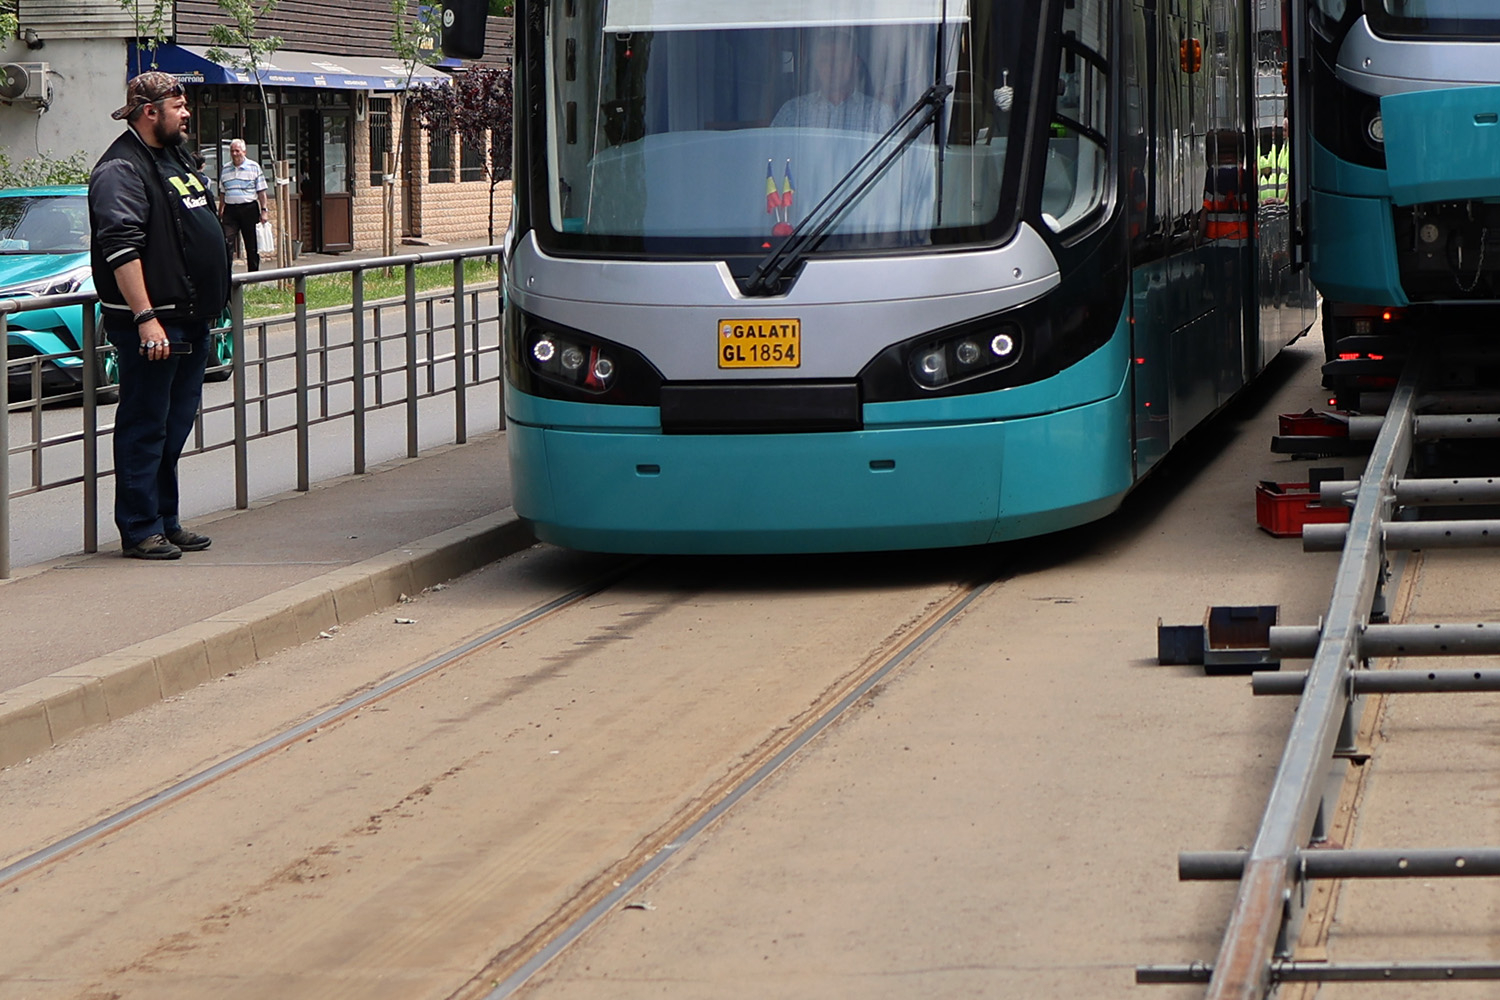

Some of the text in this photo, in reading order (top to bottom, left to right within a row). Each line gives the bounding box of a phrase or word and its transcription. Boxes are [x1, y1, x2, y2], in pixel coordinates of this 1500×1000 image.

[733, 325, 796, 338] GALATI
[723, 343, 796, 362] GL 1854
